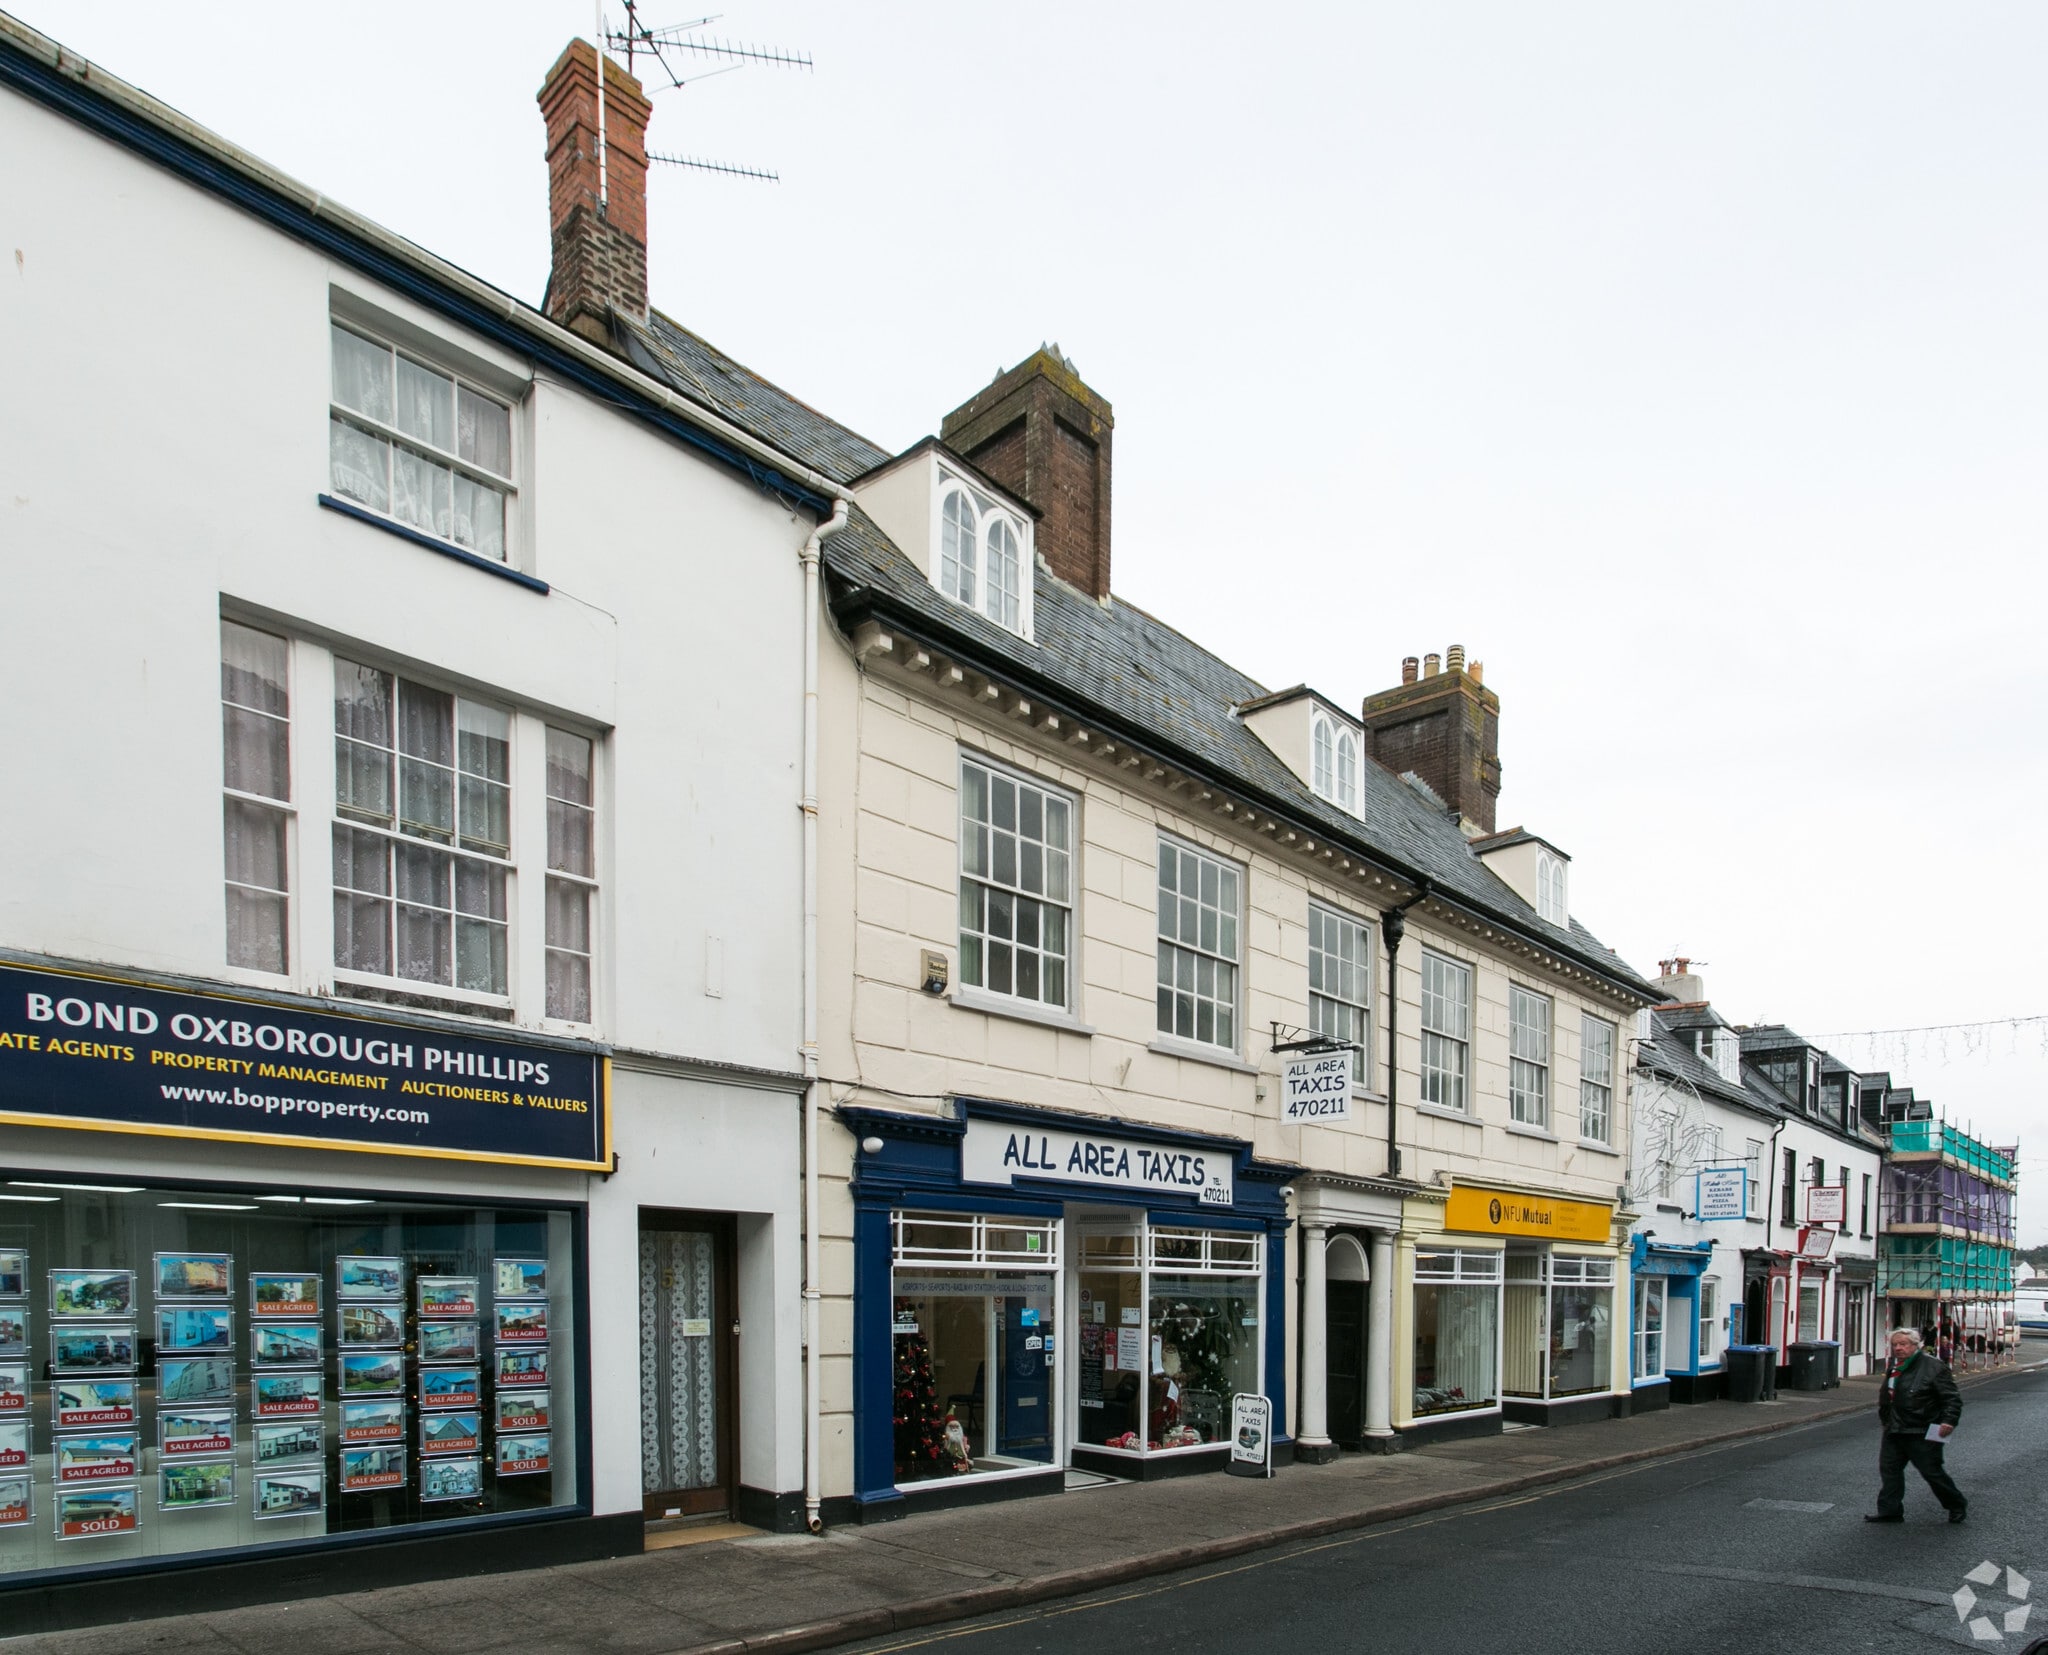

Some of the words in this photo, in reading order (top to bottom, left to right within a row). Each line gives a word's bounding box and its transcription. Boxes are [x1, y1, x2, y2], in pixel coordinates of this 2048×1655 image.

[27, 993, 158, 1034] BOND
[171, 1014, 414, 1068] OXBOROUGH
[424, 1048, 550, 1085] PHILLIPS
[47, 1038, 135, 1062] AGENTS
[151, 1050, 254, 1075] PROPERTY
[259, 1063, 389, 1090] MANAGEMENT
[401, 1080, 509, 1104] AUCTIONEERS
[513, 1093, 524, 1106] &
[527, 1094, 588, 1113] VALUERS
[1289, 1064, 1309, 1076] ALL
[1314, 1060, 1346, 1073] AREA
[1289, 1075, 1345, 1095] TAXIS
[161, 1083, 430, 1124] www.bopproperty.com
[1288, 1097, 1345, 1117] 470211
[1004, 1133, 1056, 1170] ALL
[1067, 1141, 1130, 1179] AREA
[1137, 1150, 1205, 1186] TAXIS
[1204, 1188, 1230, 1203] 470211
[1504, 1205, 1520, 1222] NFU
[1522, 1207, 1552, 1225] Mutual
[662, 1268, 673, 1288] 5
[513, 1417, 537, 1426] SOLD
[1242, 1417, 1261, 1426] TAXIS
[1246, 1452, 1263, 1461] 470211
[67, 1469, 90, 1477] SALE
[92, 1466, 128, 1475] AGREED
[513, 1461, 538, 1470] SOLD
[369, 1475, 398, 1483] AGREED
[81, 1520, 119, 1532] SOLD
